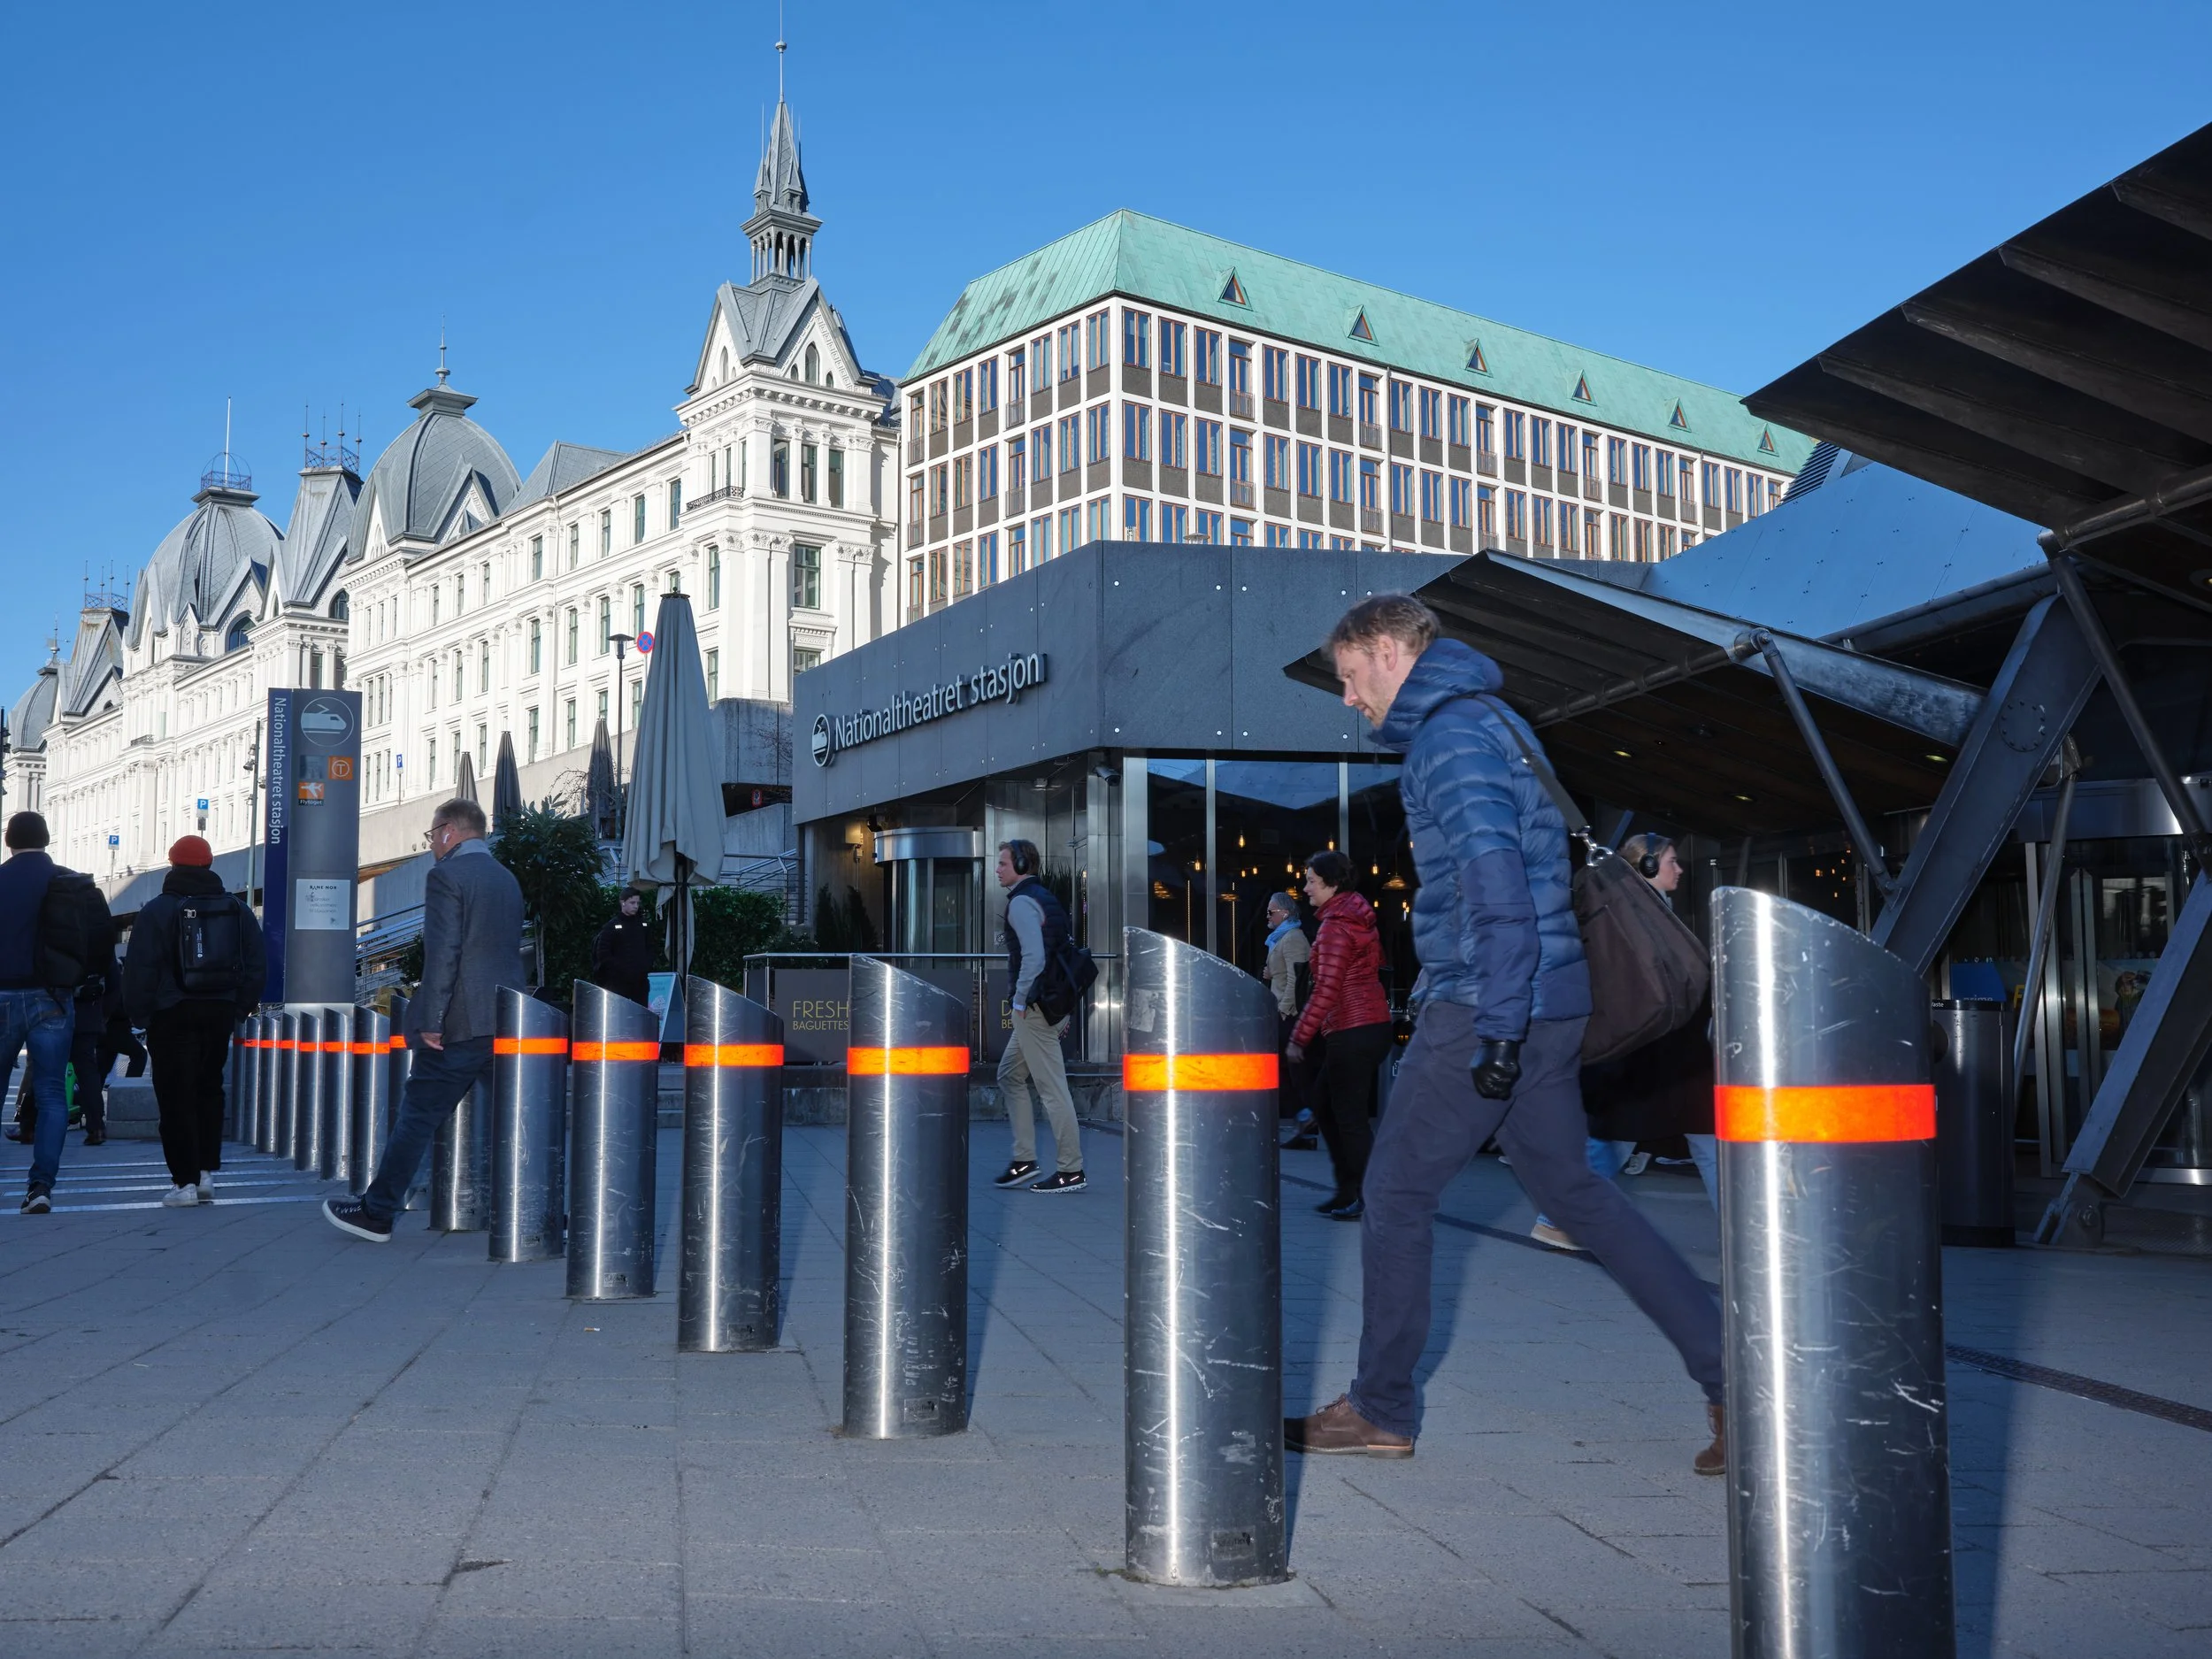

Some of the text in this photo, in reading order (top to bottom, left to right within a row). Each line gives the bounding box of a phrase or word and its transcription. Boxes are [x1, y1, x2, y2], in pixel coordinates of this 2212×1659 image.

[834, 652, 1041, 751] Nationaltheatret stasjon
[271, 697, 287, 844] Nationaltheatret stasjon
[200, 800, 207, 809] P
[793, 1000, 849, 1018] FRESH
[793, 1020, 849, 1031] BAGUETTES
